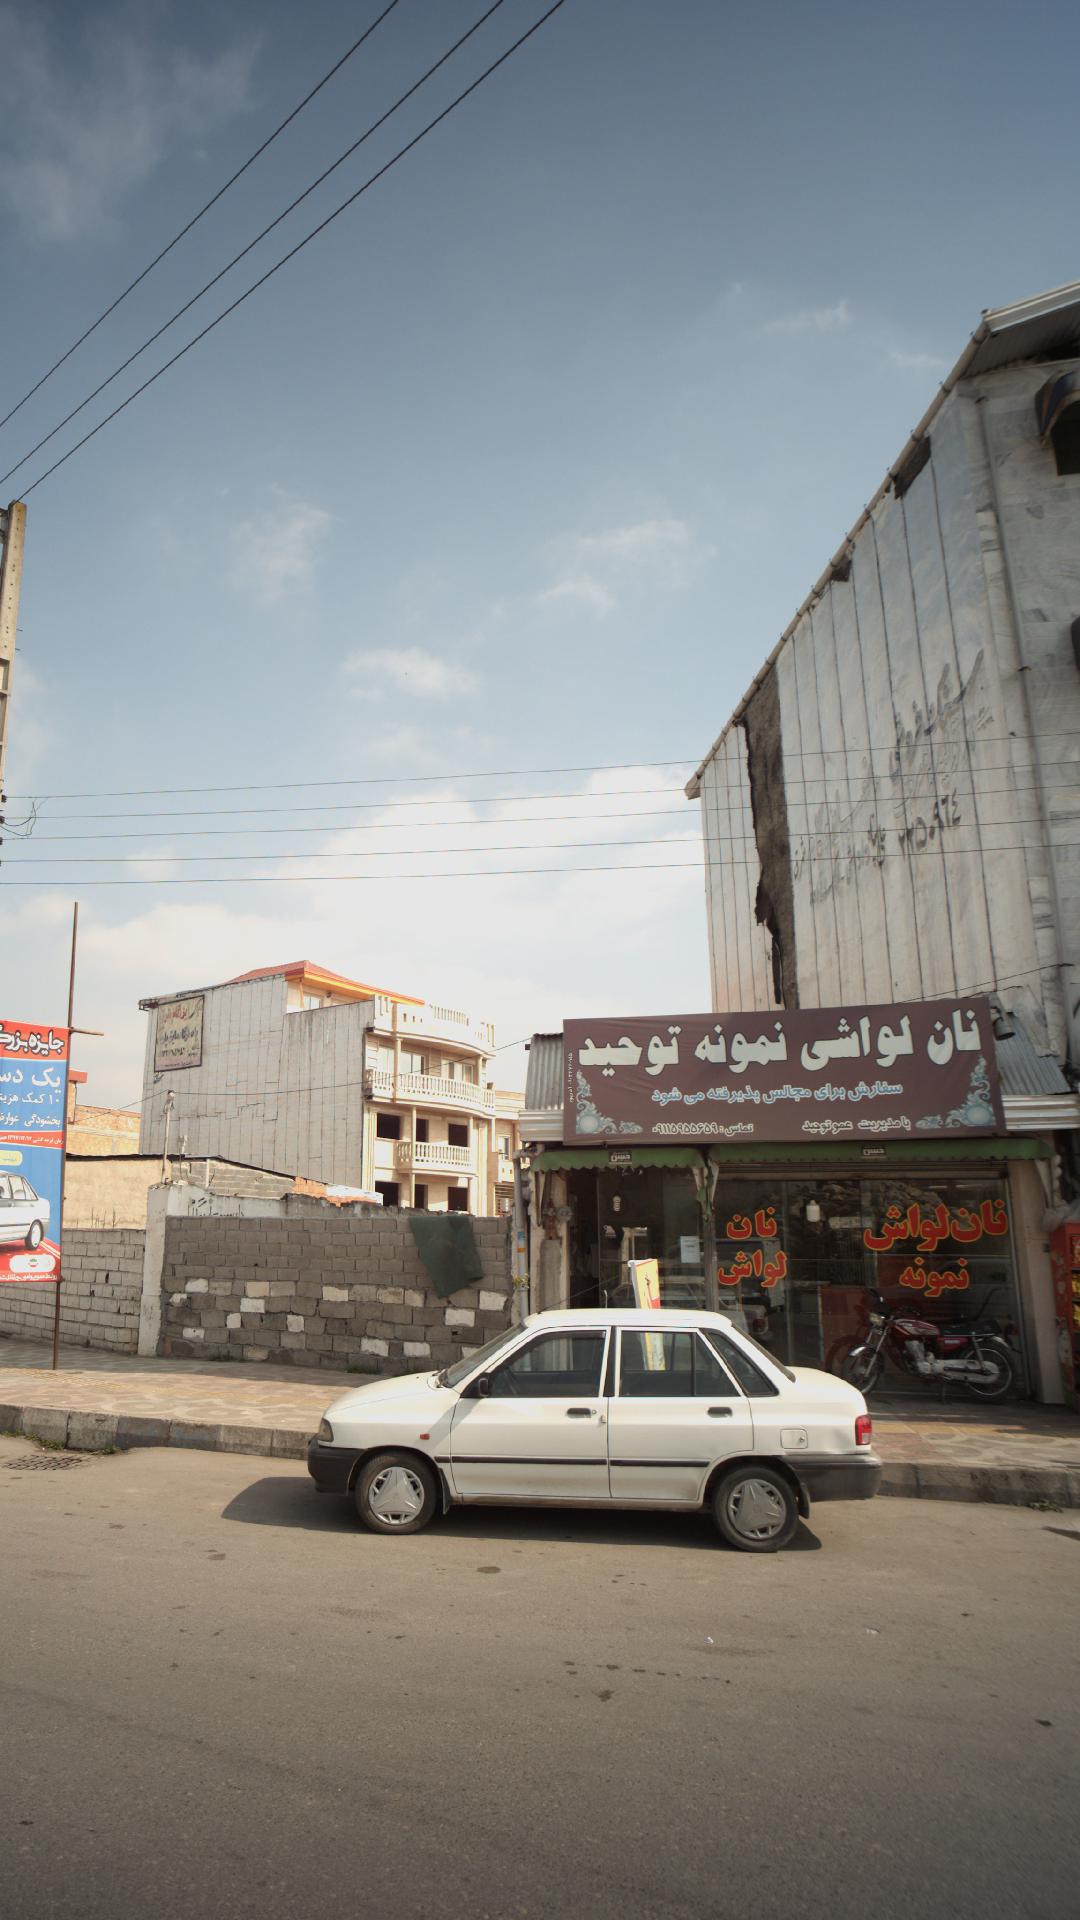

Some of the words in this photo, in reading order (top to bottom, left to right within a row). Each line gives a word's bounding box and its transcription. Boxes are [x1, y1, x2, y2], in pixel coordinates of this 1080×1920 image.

[29, 1029, 64, 1056] جایزه
[694, 1022, 787, 1073] نمونه
[927, 1009, 981, 1065] نان
[578, 1025, 682, 1077] توحید
[32, 1067, 61, 1094] یک
[814, 1083, 846, 1101] برای
[848, 1080, 903, 1101] سفارش
[22, 1091, 46, 1104] کمک
[652, 1086, 682, 1106] شود
[684, 1091, 705, 1105] می
[707, 1085, 761, 1104] پذیرفته
[762, 1084, 812, 1104] مجالس
[24, 1113, 61, 1128] بخشودگی
[802, 1119, 832, 1135] توحید
[831, 1120, 853, 1134] عمو
[727, 1206, 777, 1240] نان
[863, 1202, 950, 1252] لواش
[951, 1199, 1008, 1243] نان
[718, 1248, 787, 1287] لواش
[899, 1256, 970, 1297] نمونه
